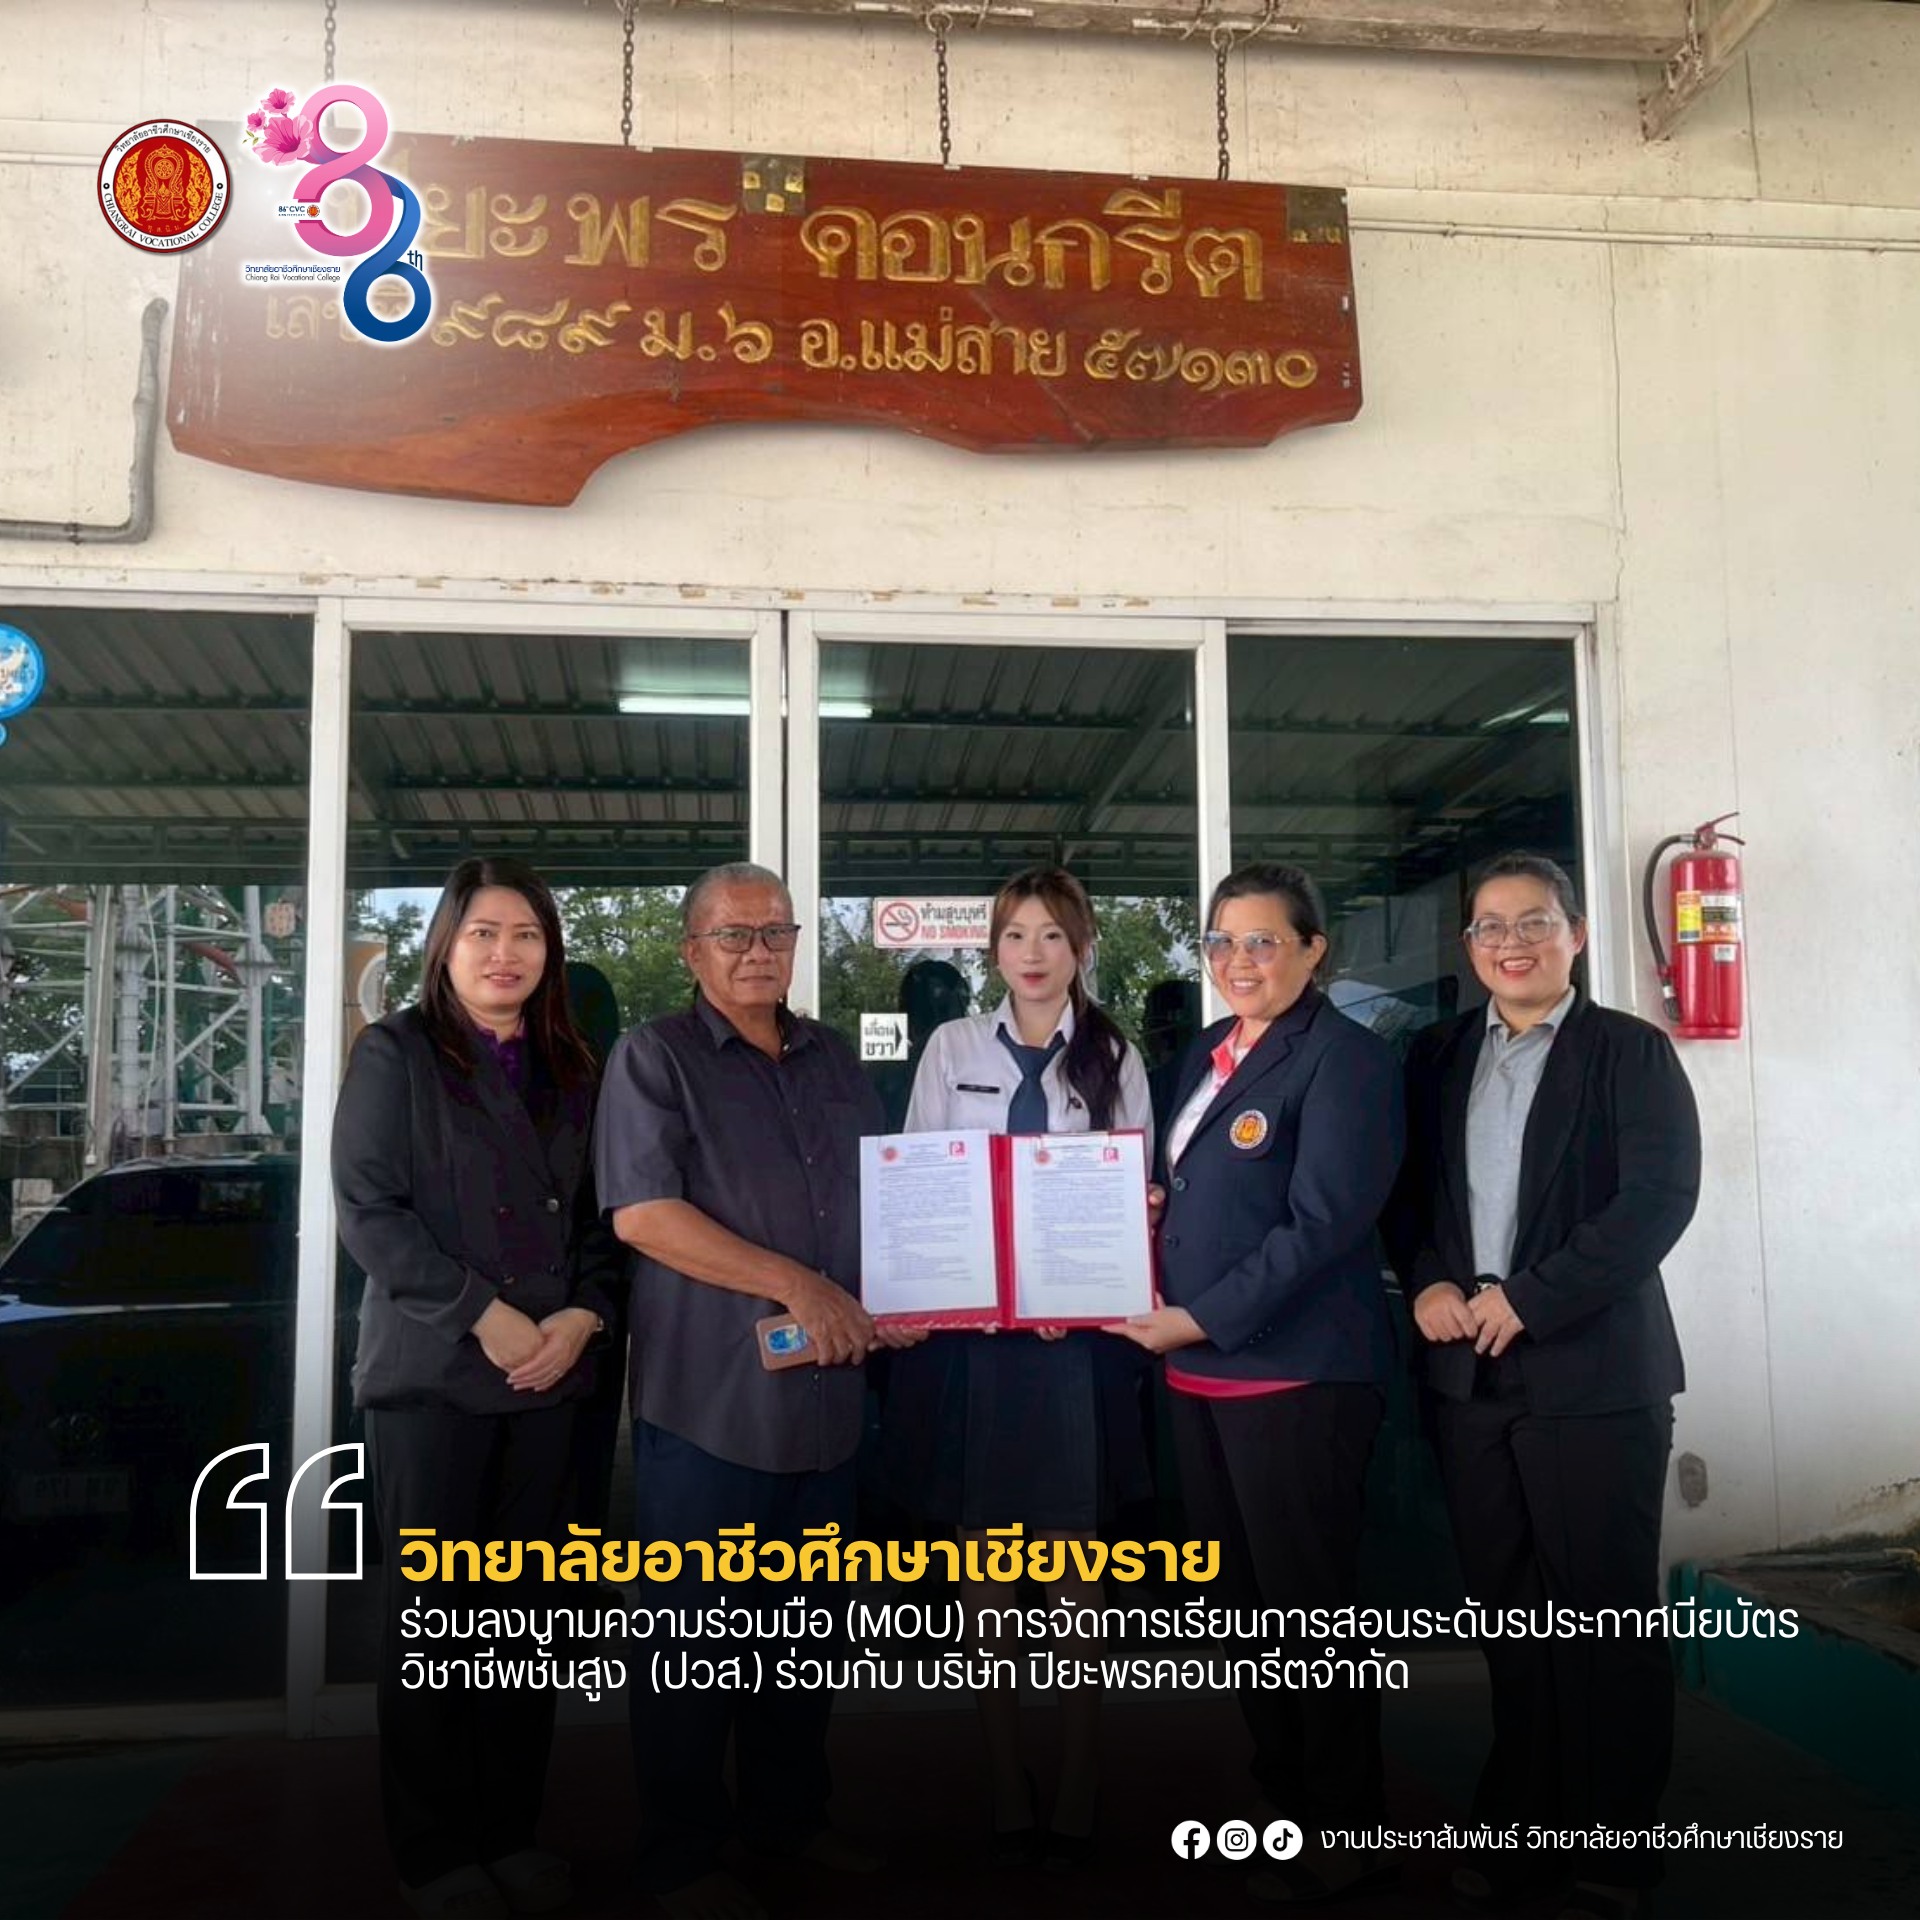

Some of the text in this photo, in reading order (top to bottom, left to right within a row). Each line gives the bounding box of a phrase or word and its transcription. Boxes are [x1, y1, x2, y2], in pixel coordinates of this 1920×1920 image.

[800, 188, 1263, 300] คอนกรีต
[800, 307, 1068, 377] อ.แม่สาย
[1084, 328, 1318, 392] ๕๗๑๓๐
